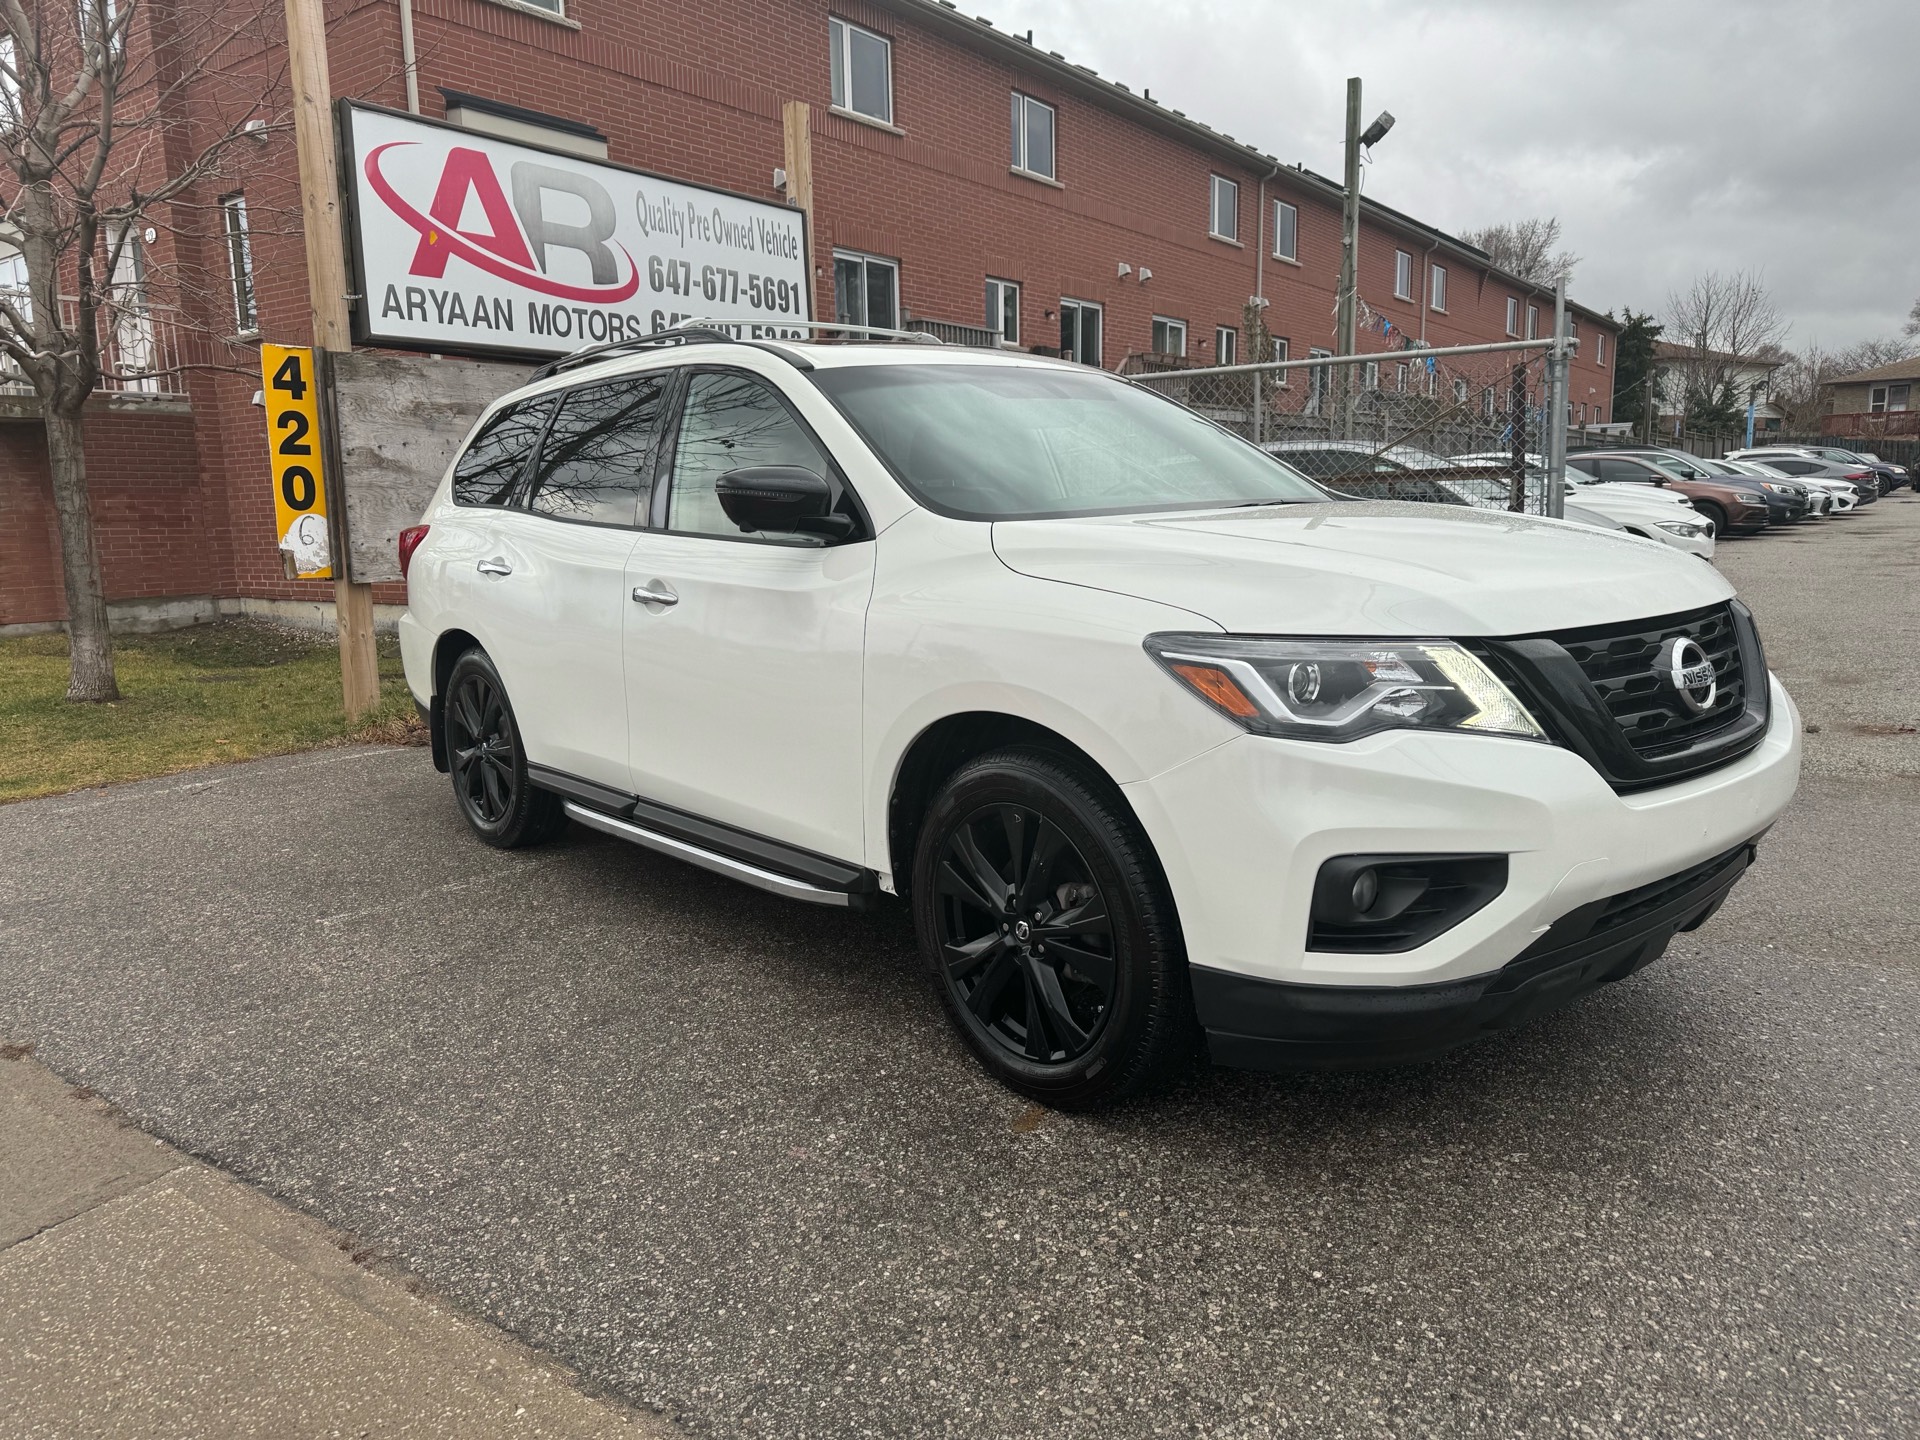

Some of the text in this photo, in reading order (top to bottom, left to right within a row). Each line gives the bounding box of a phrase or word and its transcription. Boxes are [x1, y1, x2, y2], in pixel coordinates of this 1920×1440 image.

[408, 147, 619, 285] AR
[635, 190, 798, 260] Quality Pre Owned Vehicle
[381, 283, 514, 332] ARYAAN
[528, 301, 641, 342] MOTORS
[648, 254, 800, 315] 647-677-5691
[272, 355, 316, 511] 420
